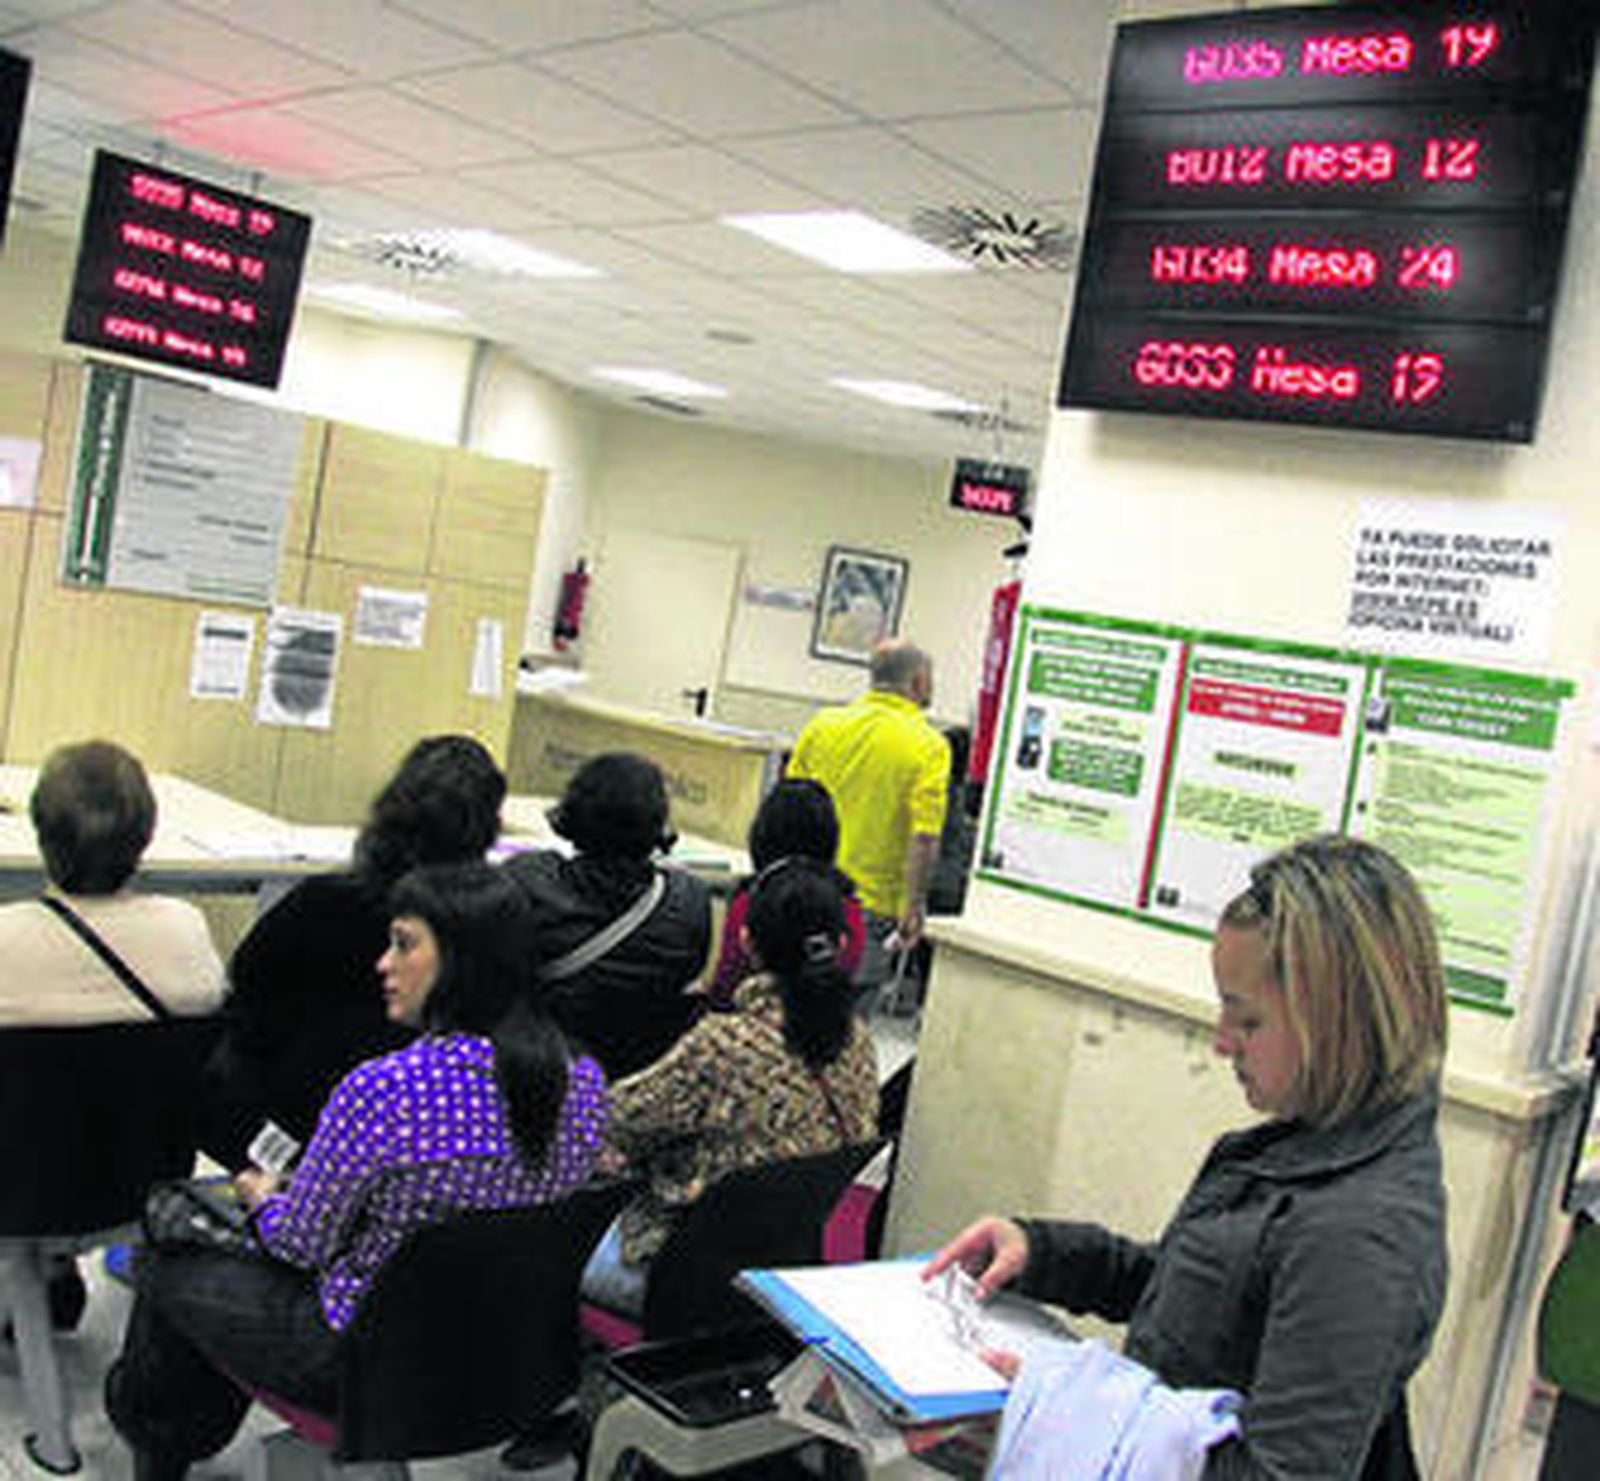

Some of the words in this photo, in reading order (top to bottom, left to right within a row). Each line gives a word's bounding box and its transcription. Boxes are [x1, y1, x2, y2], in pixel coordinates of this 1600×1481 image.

[1300, 33, 1412, 74] Mesa
[1285, 141, 1396, 182] Mesa
[1422, 139, 1480, 179] 12
[1269, 244, 1376, 285] Mesa
[1398, 245, 1459, 288] 24
[1250, 346, 1359, 396] Mesa
[1389, 530, 1446, 550] PUEDE
[1452, 534, 1552, 556] SOLICITAR
[1355, 570, 1391, 587] POR
[1356, 552, 1390, 568] LAS
[1395, 552, 1538, 579] PRESTACIONES
